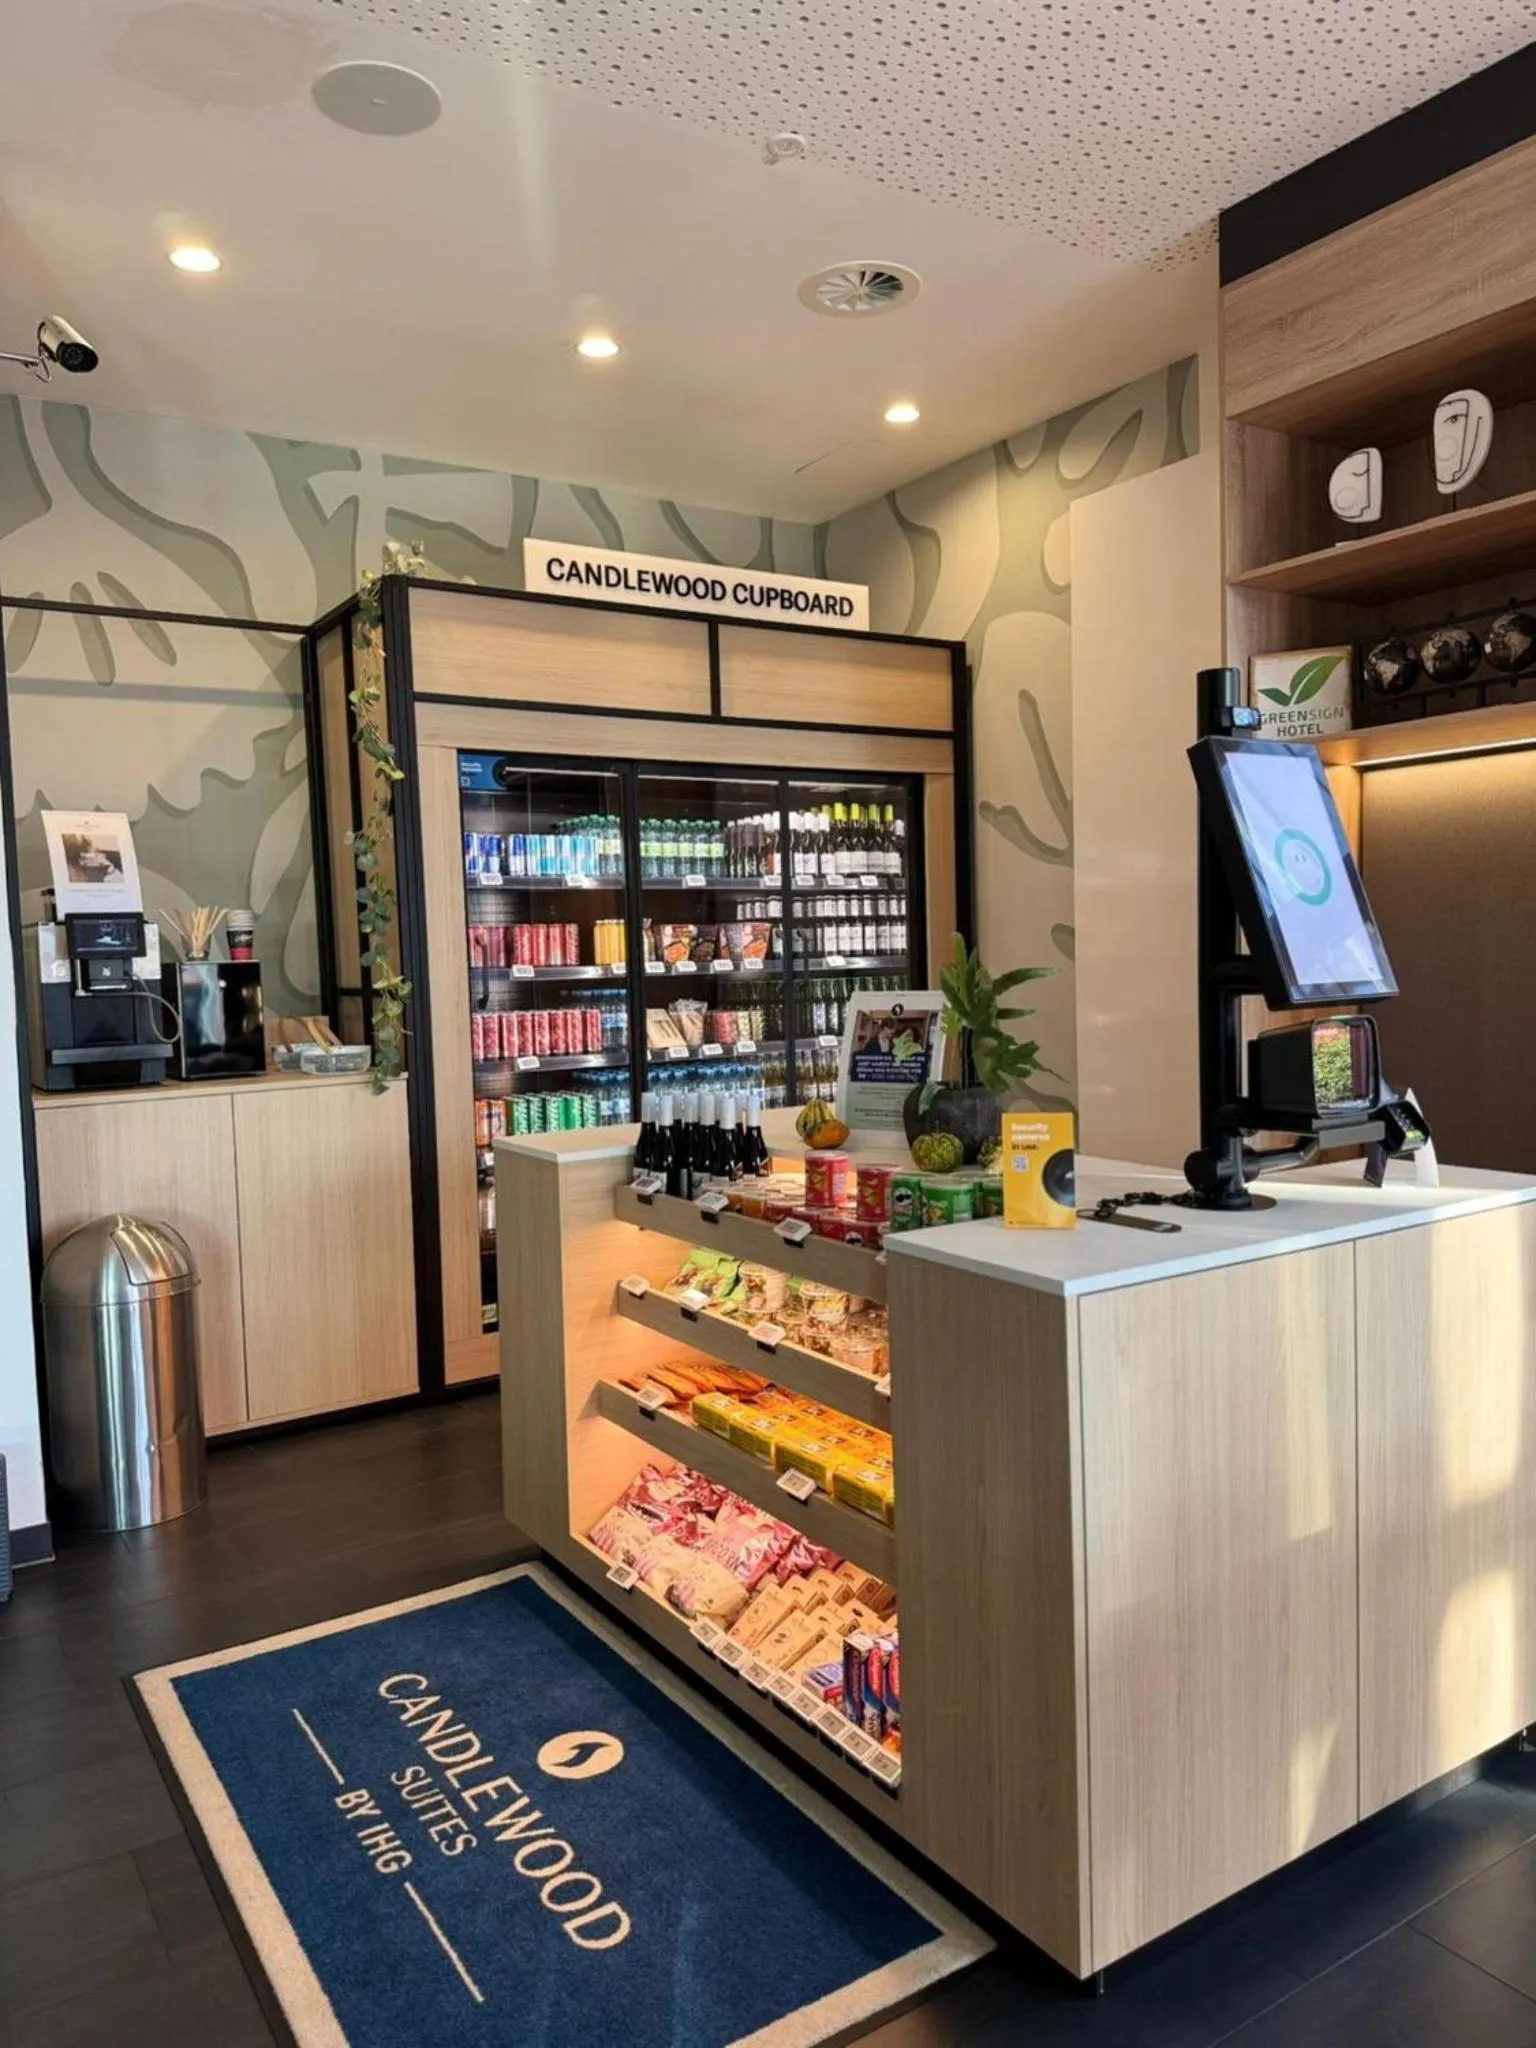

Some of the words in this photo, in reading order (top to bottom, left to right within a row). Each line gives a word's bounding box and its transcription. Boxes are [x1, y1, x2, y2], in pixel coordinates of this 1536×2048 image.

[546, 557, 726, 602] CANDLEWOOD
[733, 582, 854, 617] CUPBOARD
[1277, 723, 1324, 737] HOTEL
[335, 1788, 382, 1820] BY
[378, 1673, 632, 1950] CANDLEWOOD
[391, 1765, 478, 1857] SUITES
[357, 1822, 413, 1874] IHG
